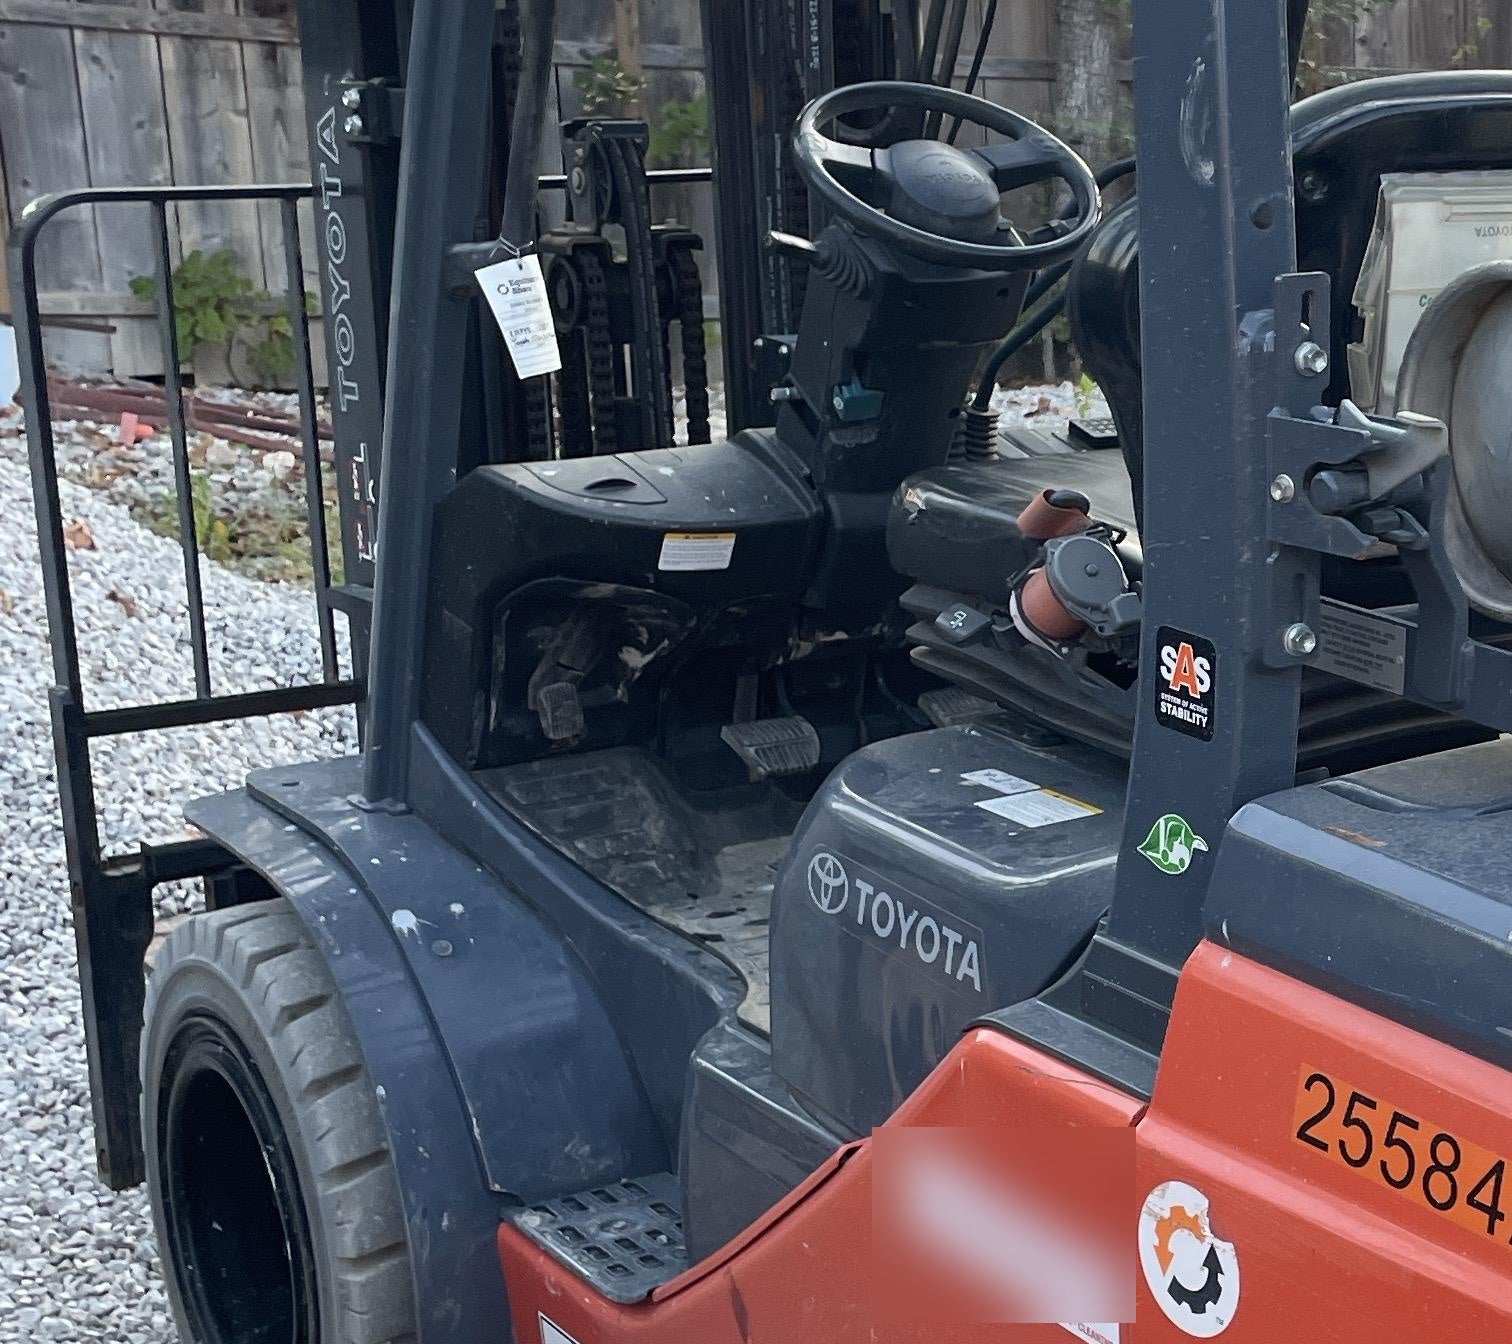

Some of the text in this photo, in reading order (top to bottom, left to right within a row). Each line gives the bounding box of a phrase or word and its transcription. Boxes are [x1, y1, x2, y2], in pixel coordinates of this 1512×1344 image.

[317, 106, 360, 413] TOYOTA
[1159, 641, 1211, 699] SAS
[1160, 701, 1208, 728] STABILITY
[854, 877, 984, 993] TOYOTA
